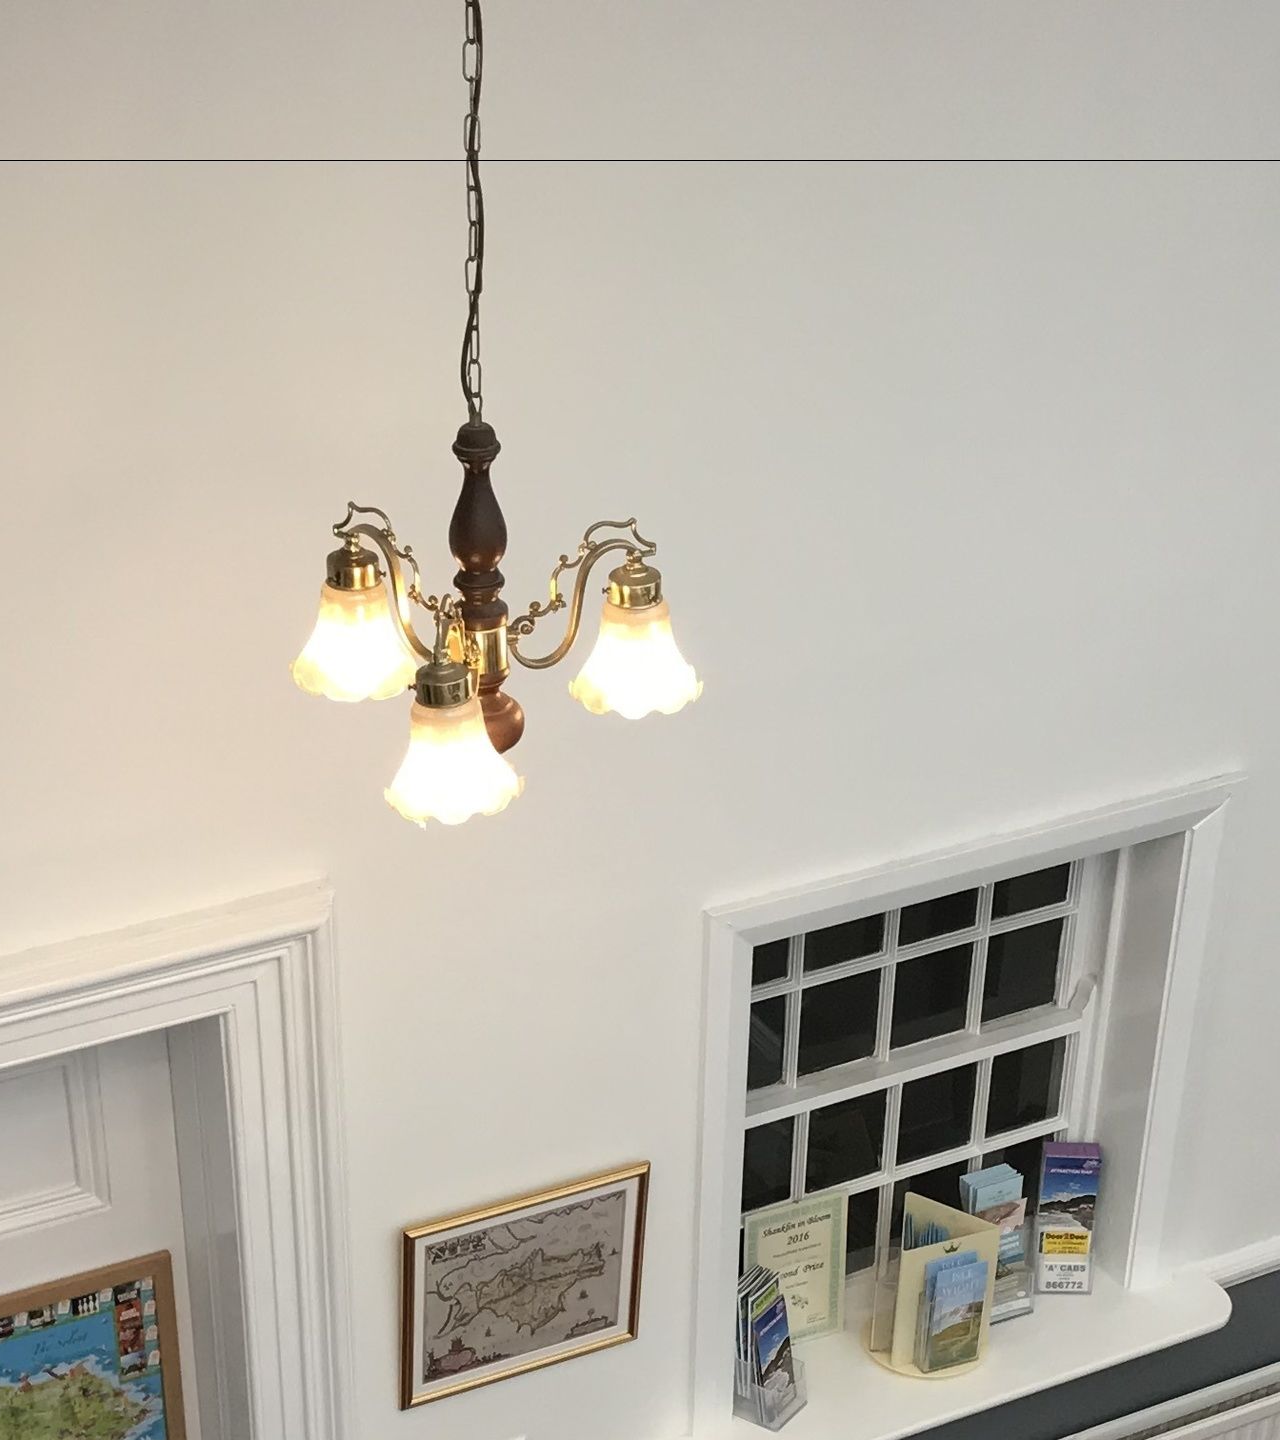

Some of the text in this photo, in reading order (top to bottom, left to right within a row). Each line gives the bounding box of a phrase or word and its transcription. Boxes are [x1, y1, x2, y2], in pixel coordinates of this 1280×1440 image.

[761, 1213, 832, 1239] Shanklin in Bloom
[786, 1231, 810, 1246] 2016
[802, 1261, 825, 1275] Prize
[1060, 1264, 1087, 1273] CABS
[1044, 1281, 1084, 1291] 866772
